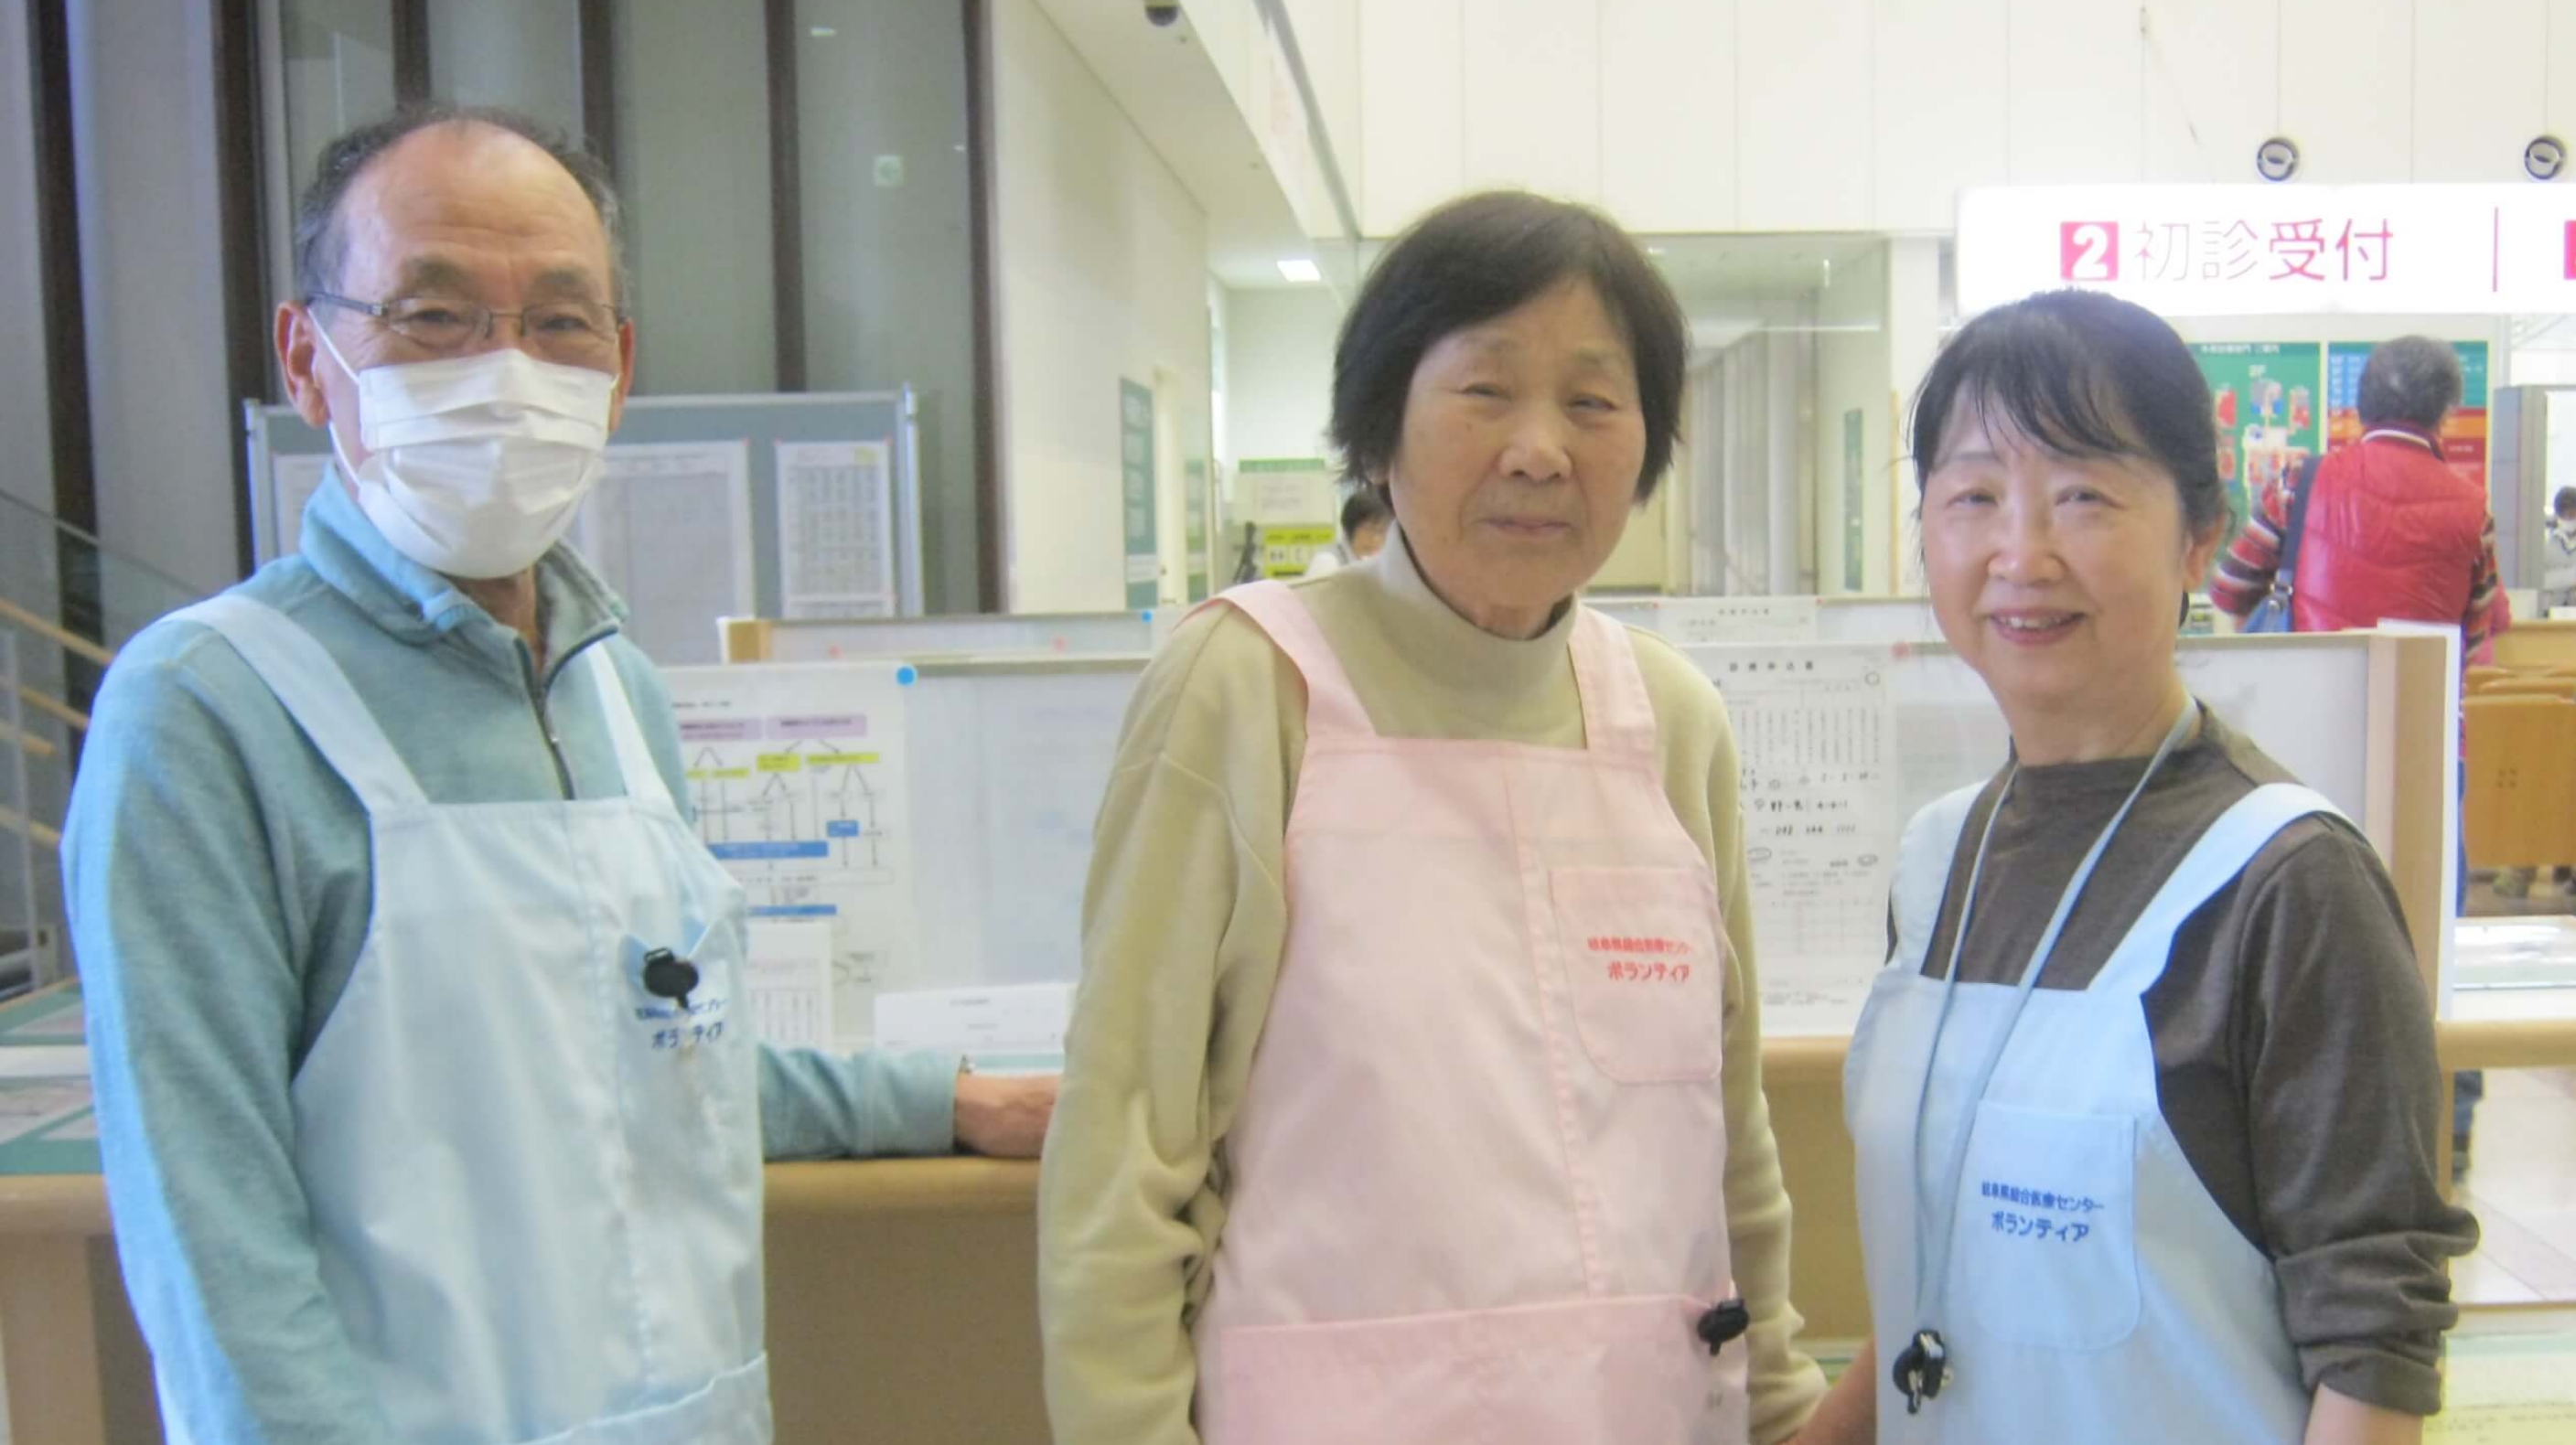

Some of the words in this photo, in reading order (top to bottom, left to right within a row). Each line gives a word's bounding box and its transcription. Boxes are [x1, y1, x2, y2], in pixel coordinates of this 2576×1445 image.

[2071, 223, 2109, 280] 2
[2134, 219, 2394, 281] 初診受付
[1607, 961, 1690, 982] ボランティア
[1991, 1210, 2090, 1243] ボランティア
